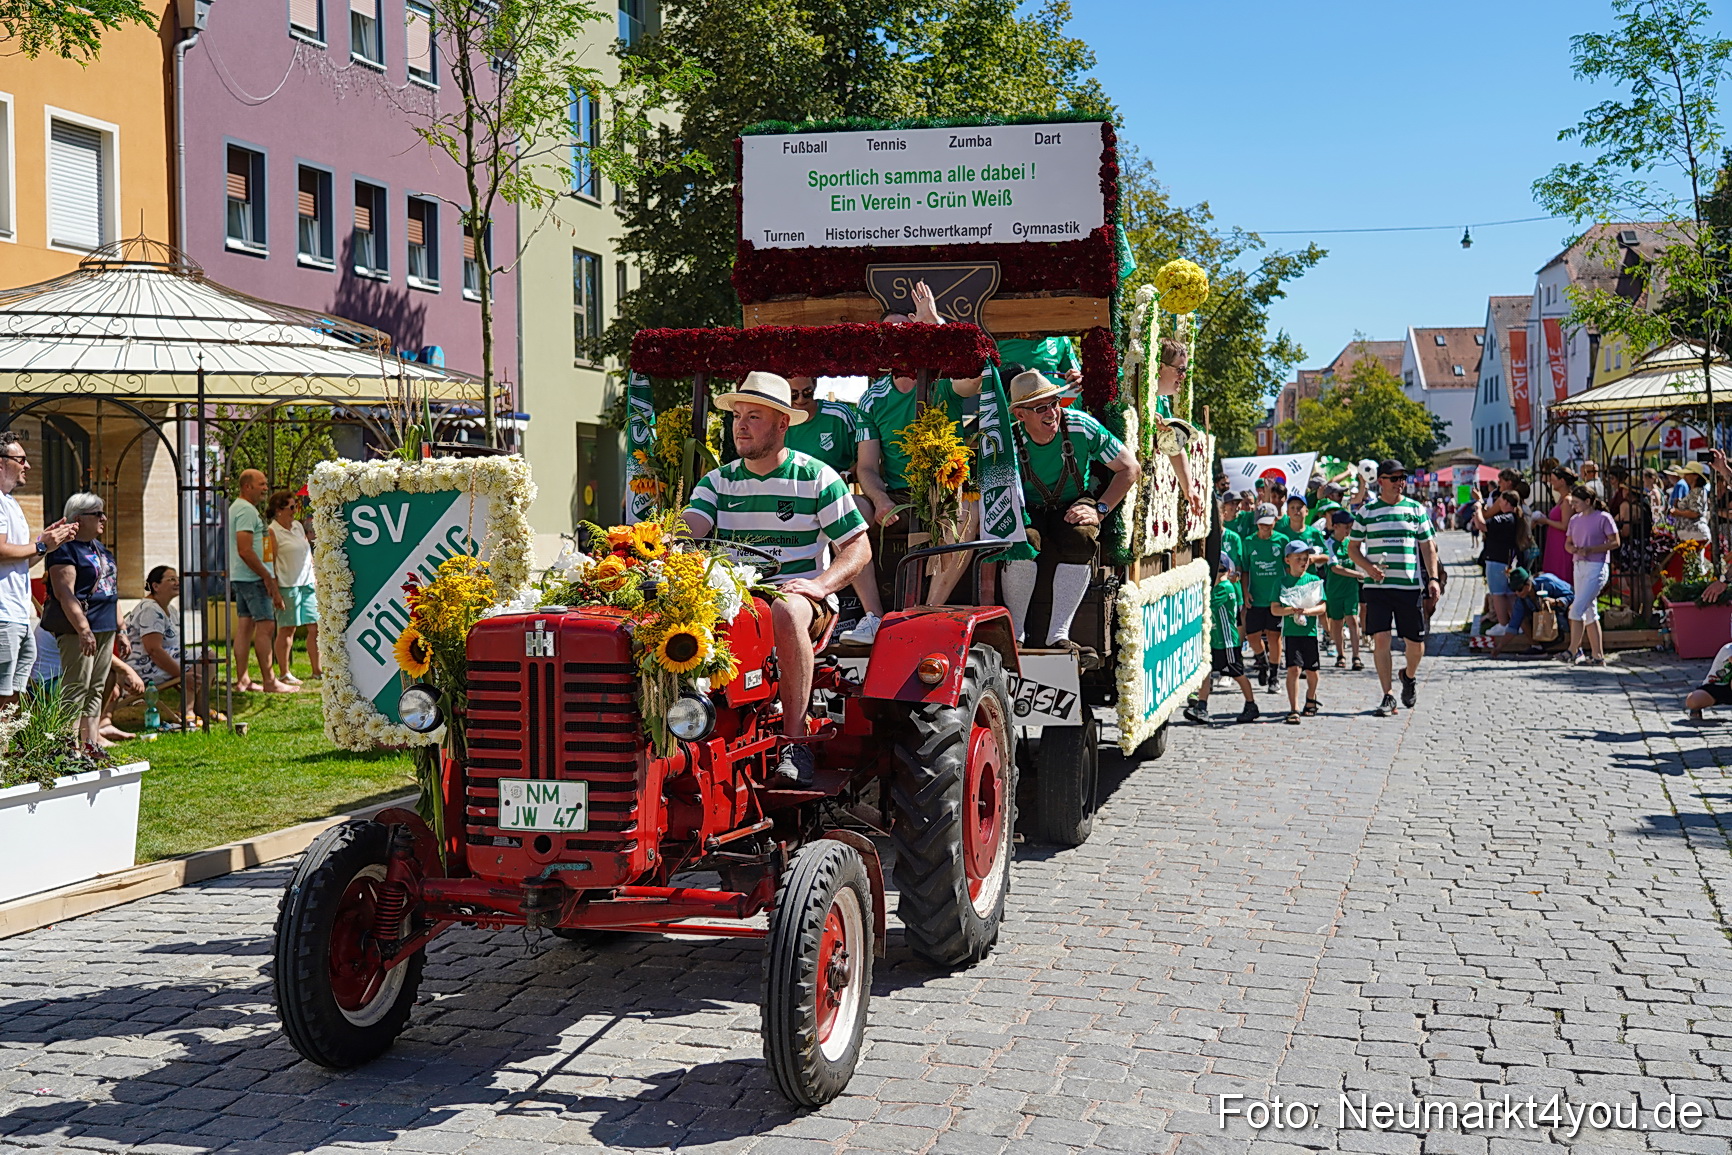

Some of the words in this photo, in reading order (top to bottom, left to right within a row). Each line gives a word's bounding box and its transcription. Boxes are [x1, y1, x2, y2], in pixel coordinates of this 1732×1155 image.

[783, 141, 828, 154] Fußball
[866, 138, 907, 151] Tennis
[949, 135, 992, 148] Zumba
[1034, 132, 1061, 145] Dart
[807, 168, 879, 191] Sportlich
[884, 170, 942, 185] samma
[947, 165, 975, 182] alle
[980, 163, 1026, 181] dabei
[1031, 162, 1036, 180] !
[831, 194, 856, 211] Ein
[860, 193, 911, 211] Verein
[926, 191, 967, 209] Grün
[971, 188, 1013, 207] Weiß
[764, 230, 805, 242] Turnen
[825, 226, 900, 240] Historischer
[903, 223, 992, 239] Schwertkampf
[1012, 221, 1080, 238] Gymnastik
[986, 490, 996, 504] SV
[986, 495, 1010, 526] PÖLLING
[351, 502, 410, 546] SV
[997, 515, 1013, 531] 1950
[1143, 596, 1168, 652] OMOS
[1169, 590, 1184, 636] LOS
[1155, 655, 1173, 706] SAN
[526, 783, 559, 805] NM
[511, 806, 538, 827] JW
[553, 807, 578, 828] 47
